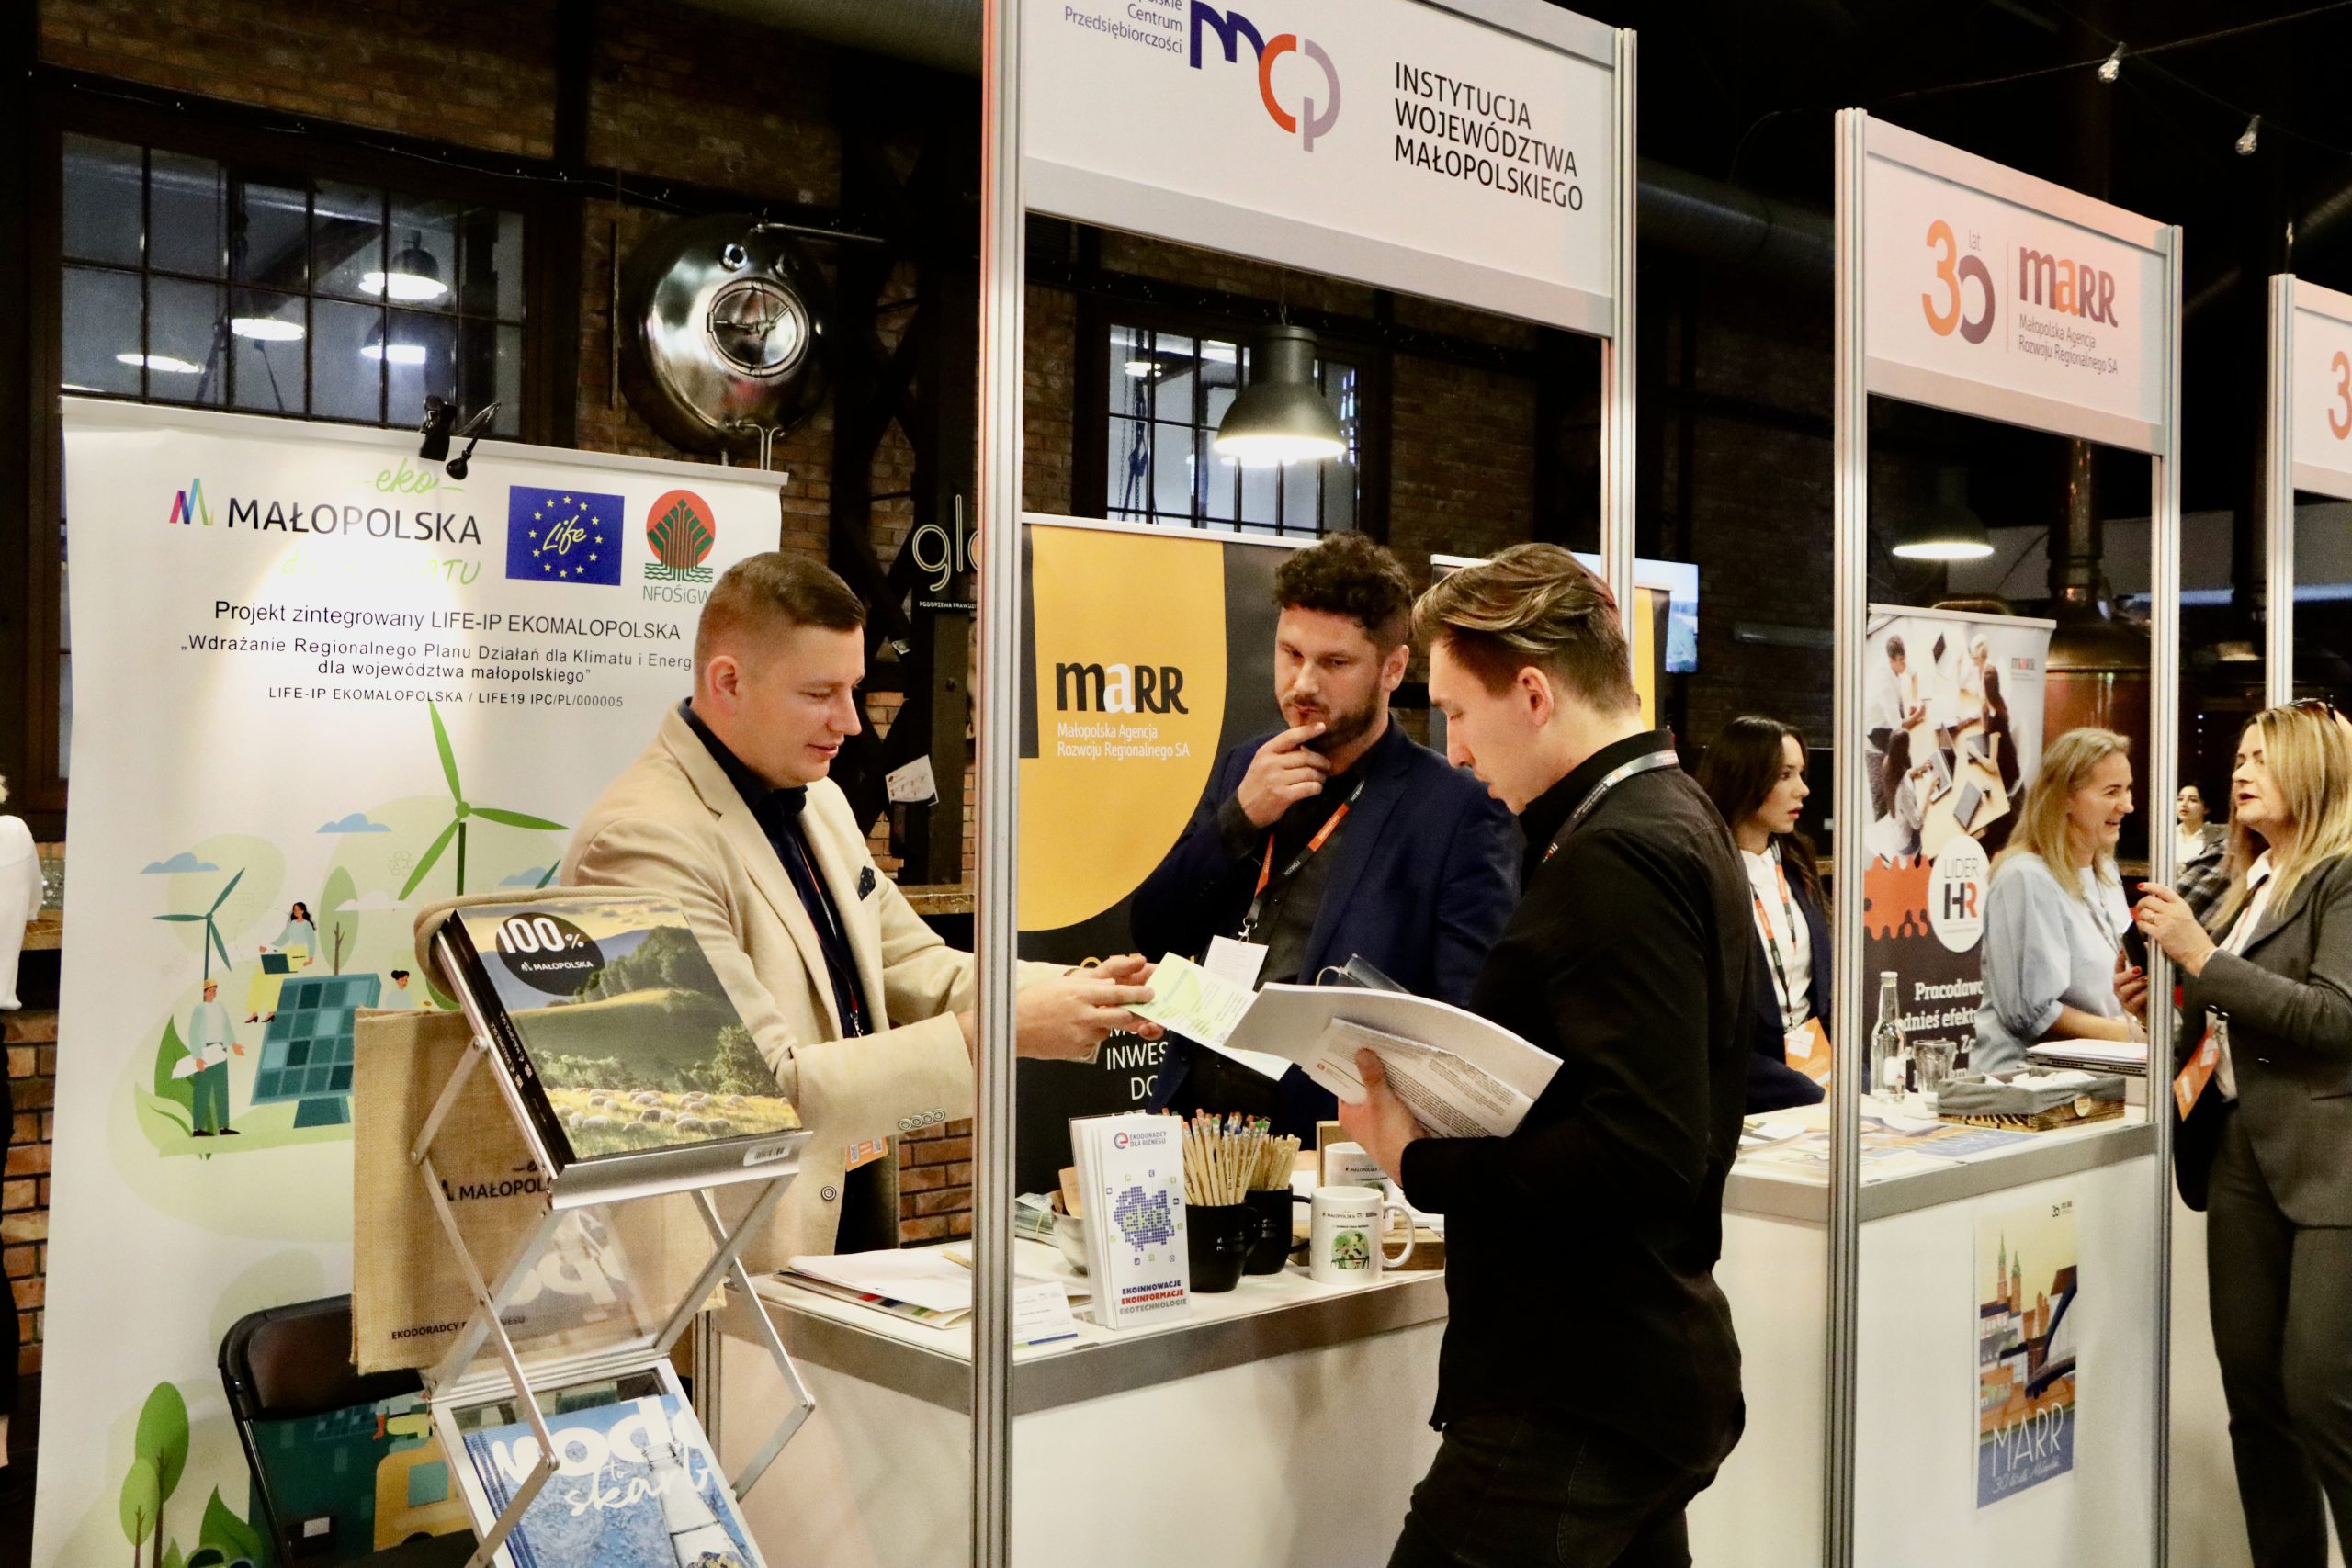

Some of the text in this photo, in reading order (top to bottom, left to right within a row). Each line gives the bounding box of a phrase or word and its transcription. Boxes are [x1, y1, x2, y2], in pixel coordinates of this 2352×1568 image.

[1064, 6, 1182, 54] Przedsiębiorczości
[1127, 3, 1182, 32] Centrum
[1396, 62, 1532, 130] INSTYTUCJA
[1395, 97, 1578, 177] WOJEWÓDZTWA
[1396, 134, 1583, 211] MAŁOPOLSKIEGO
[1968, 229, 1982, 252] lat
[1921, 220, 1996, 344] 30
[2019, 313, 2096, 352] Małopolska Agencja
[2018, 334, 2119, 375] Rozwoju Regionalnego SA
[227, 496, 482, 546] MAŁOPOLSKA
[542, 514, 587, 555] Life
[911, 494, 978, 592] gl
[214, 600, 681, 640] Projekt zintegrowany LIFE-IP EKOMALOPOLSKA
[181, 634, 692, 671] „Wdrażanie Regionalnego Planu Działań dla Klimatu i Energ
[317, 660, 591, 685] dla województwa małopolskiego”
[268, 686, 327, 699] LIFE-IP
[333, 687, 464, 704] EKOMALOPOLSKA
[478, 692, 525, 705] LIFE19
[530, 692, 624, 707] IPC/PL/000005
[1057, 721, 1159, 742] Małopolska Agencja
[1057, 740, 1191, 761] Rozwoju Regionalnego SA
[1943, 857, 1979, 879] LIDER
[1943, 881, 1978, 919] HR
[497, 917, 584, 954] 100%
[533, 960, 594, 971] MAŁOPOLSKA
[1129, 1131, 1167, 1141] EKODORADCY
[1142, 1138, 1166, 1146] BIZNESU
[1119, 1297, 1187, 1315] EKOTECHNOLOGIE
[1121, 1288, 1184, 1305] EKOINFORMACJE
[1122, 1280, 1182, 1295] EKOINNOWACJE
[391, 1322, 458, 1340] EKODORADCY
[1991, 1402, 2061, 1478] MARR
